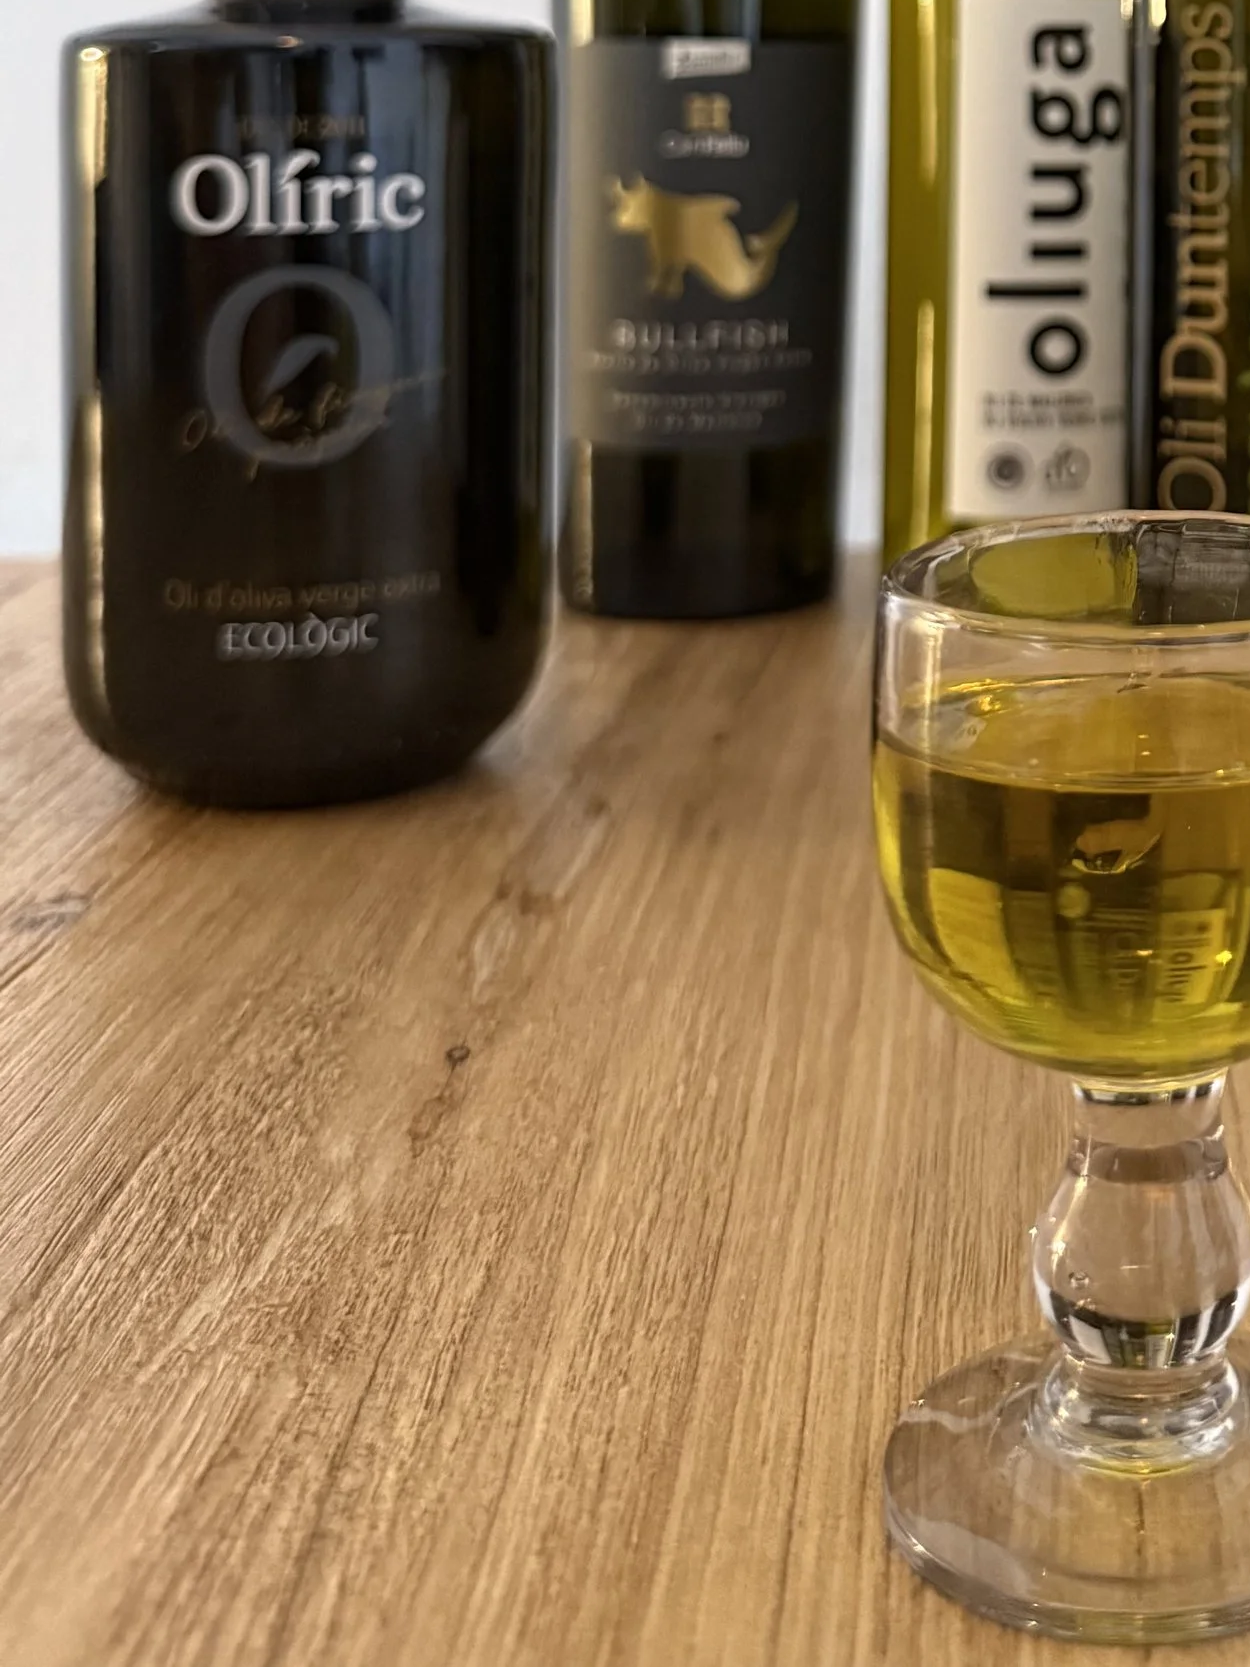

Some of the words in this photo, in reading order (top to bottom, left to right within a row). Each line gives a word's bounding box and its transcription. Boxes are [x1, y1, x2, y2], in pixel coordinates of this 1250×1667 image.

[171, 149, 426, 234] Olíric
[1159, 2, 1245, 404] Duntemps
[1157, 419, 1226, 511] Oli
[217, 611, 380, 662] ECOLÒGIC
